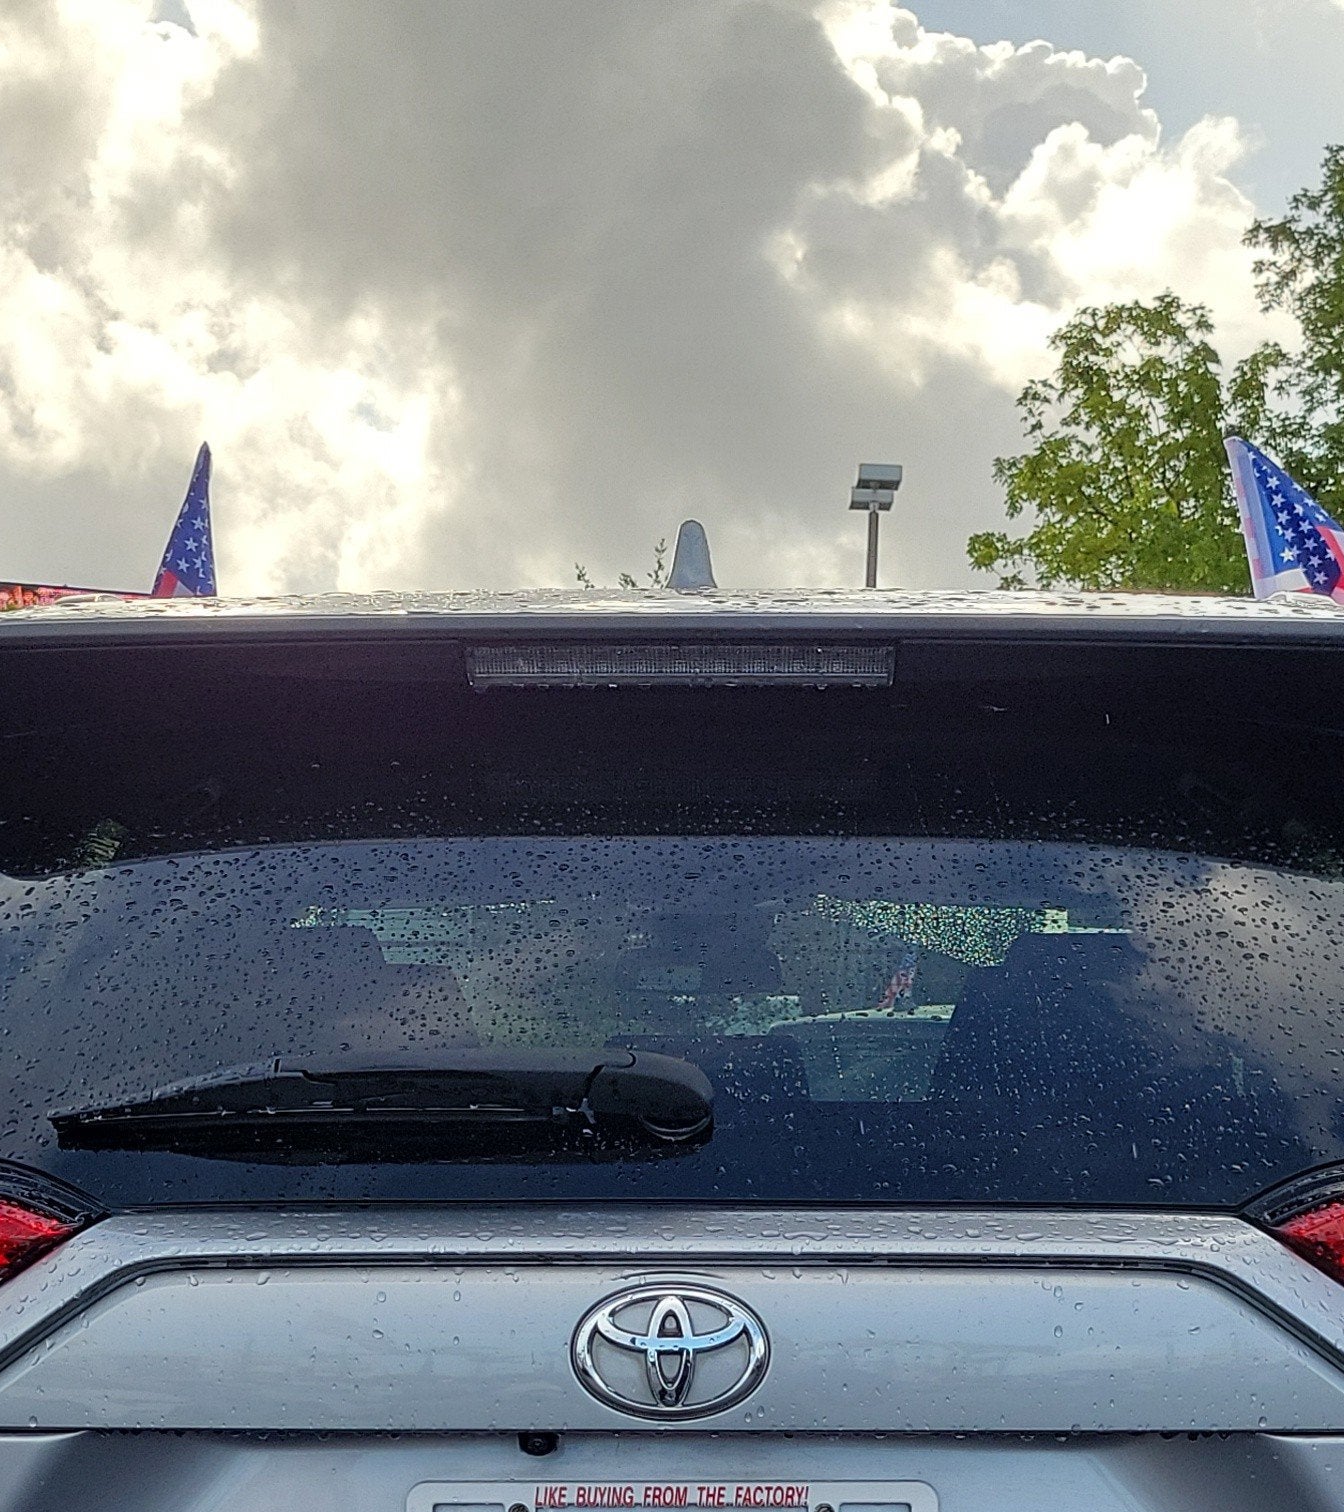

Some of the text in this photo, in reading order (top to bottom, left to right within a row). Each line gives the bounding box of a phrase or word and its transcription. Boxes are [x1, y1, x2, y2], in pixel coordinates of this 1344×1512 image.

[534, 1485, 810, 1509] LIKE BUYING FROM THE FACTORY!
